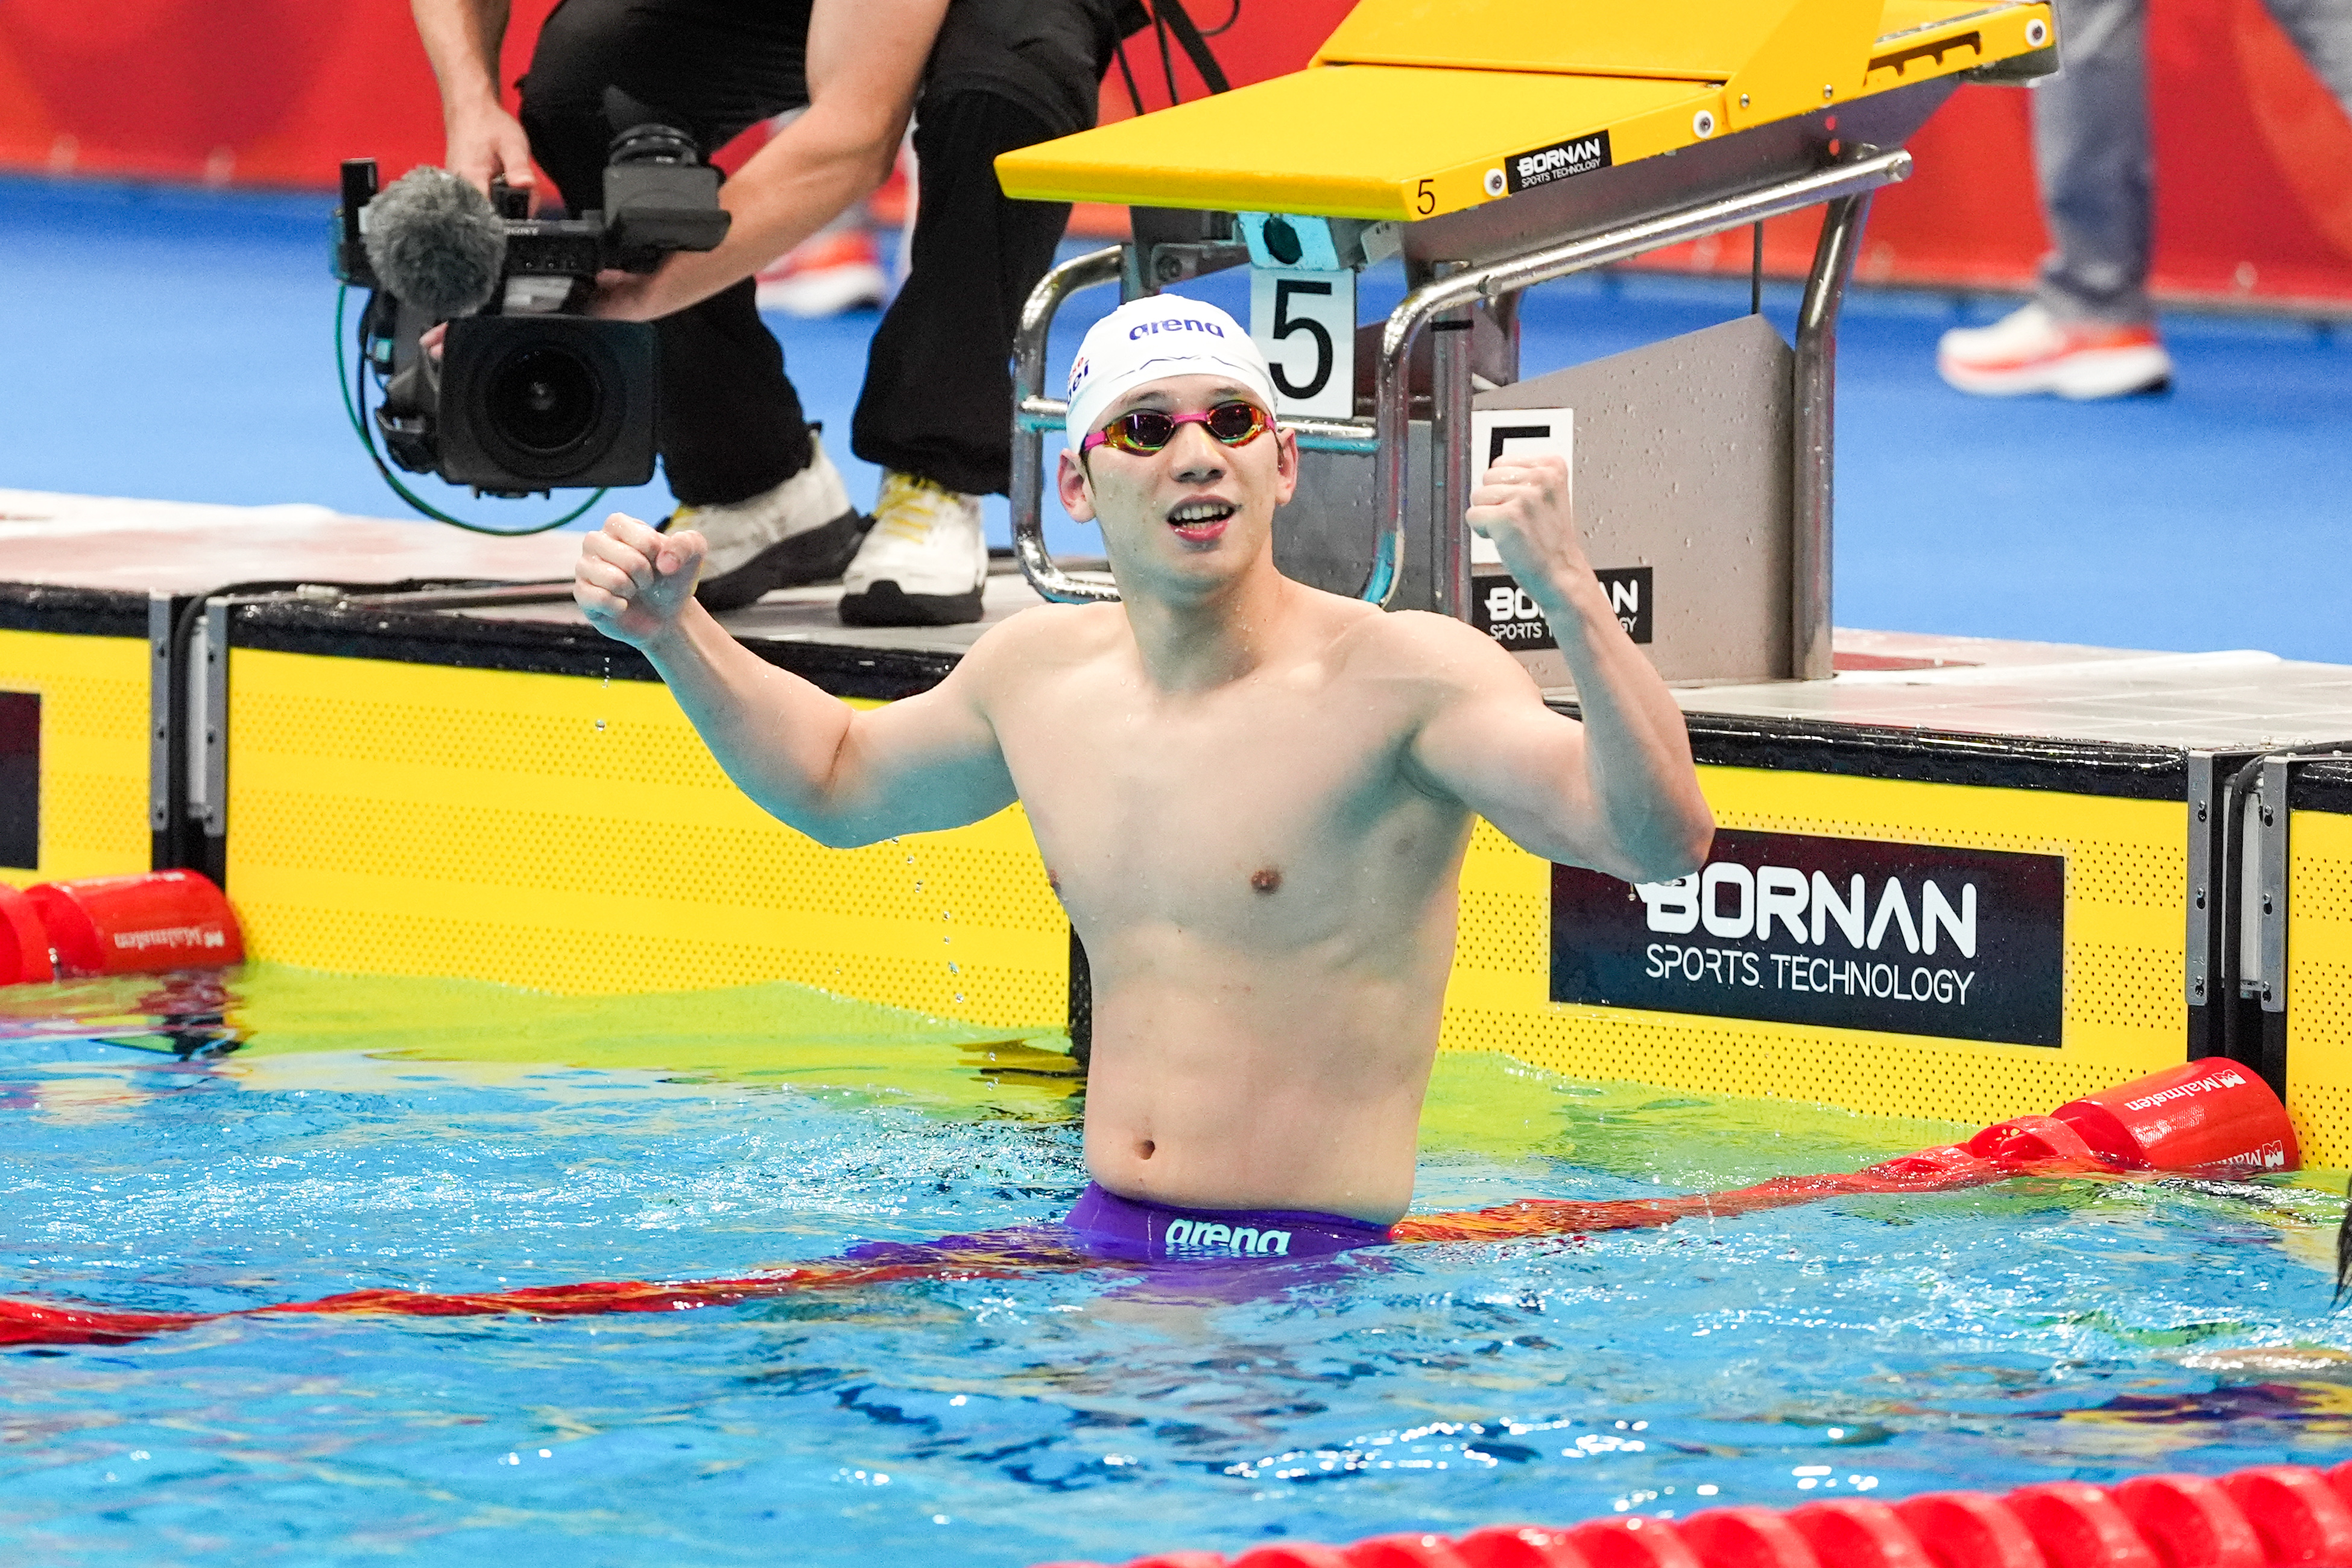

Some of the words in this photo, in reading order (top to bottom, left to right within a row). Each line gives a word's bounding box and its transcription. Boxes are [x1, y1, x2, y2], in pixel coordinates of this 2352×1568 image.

[1517, 138, 1601, 177] BORNAN
[1521, 172, 1551, 189] SPORTS
[1552, 157, 1601, 180] TECHNOLOGY
[1417, 179, 1435, 215] 5
[1129, 318, 1225, 341] arena
[1269, 279, 1333, 399] 5
[1484, 580, 1639, 622] BON
[1490, 622, 1542, 640] SPORTS
[1635, 862, 1976, 959] BORNAN
[1645, 944, 1759, 985] SPORTS
[1770, 954, 1976, 1005] TECHNOLOGY
[2125, 1077, 2222, 1111] Malmsten
[1165, 1218, 1291, 1255] arena
